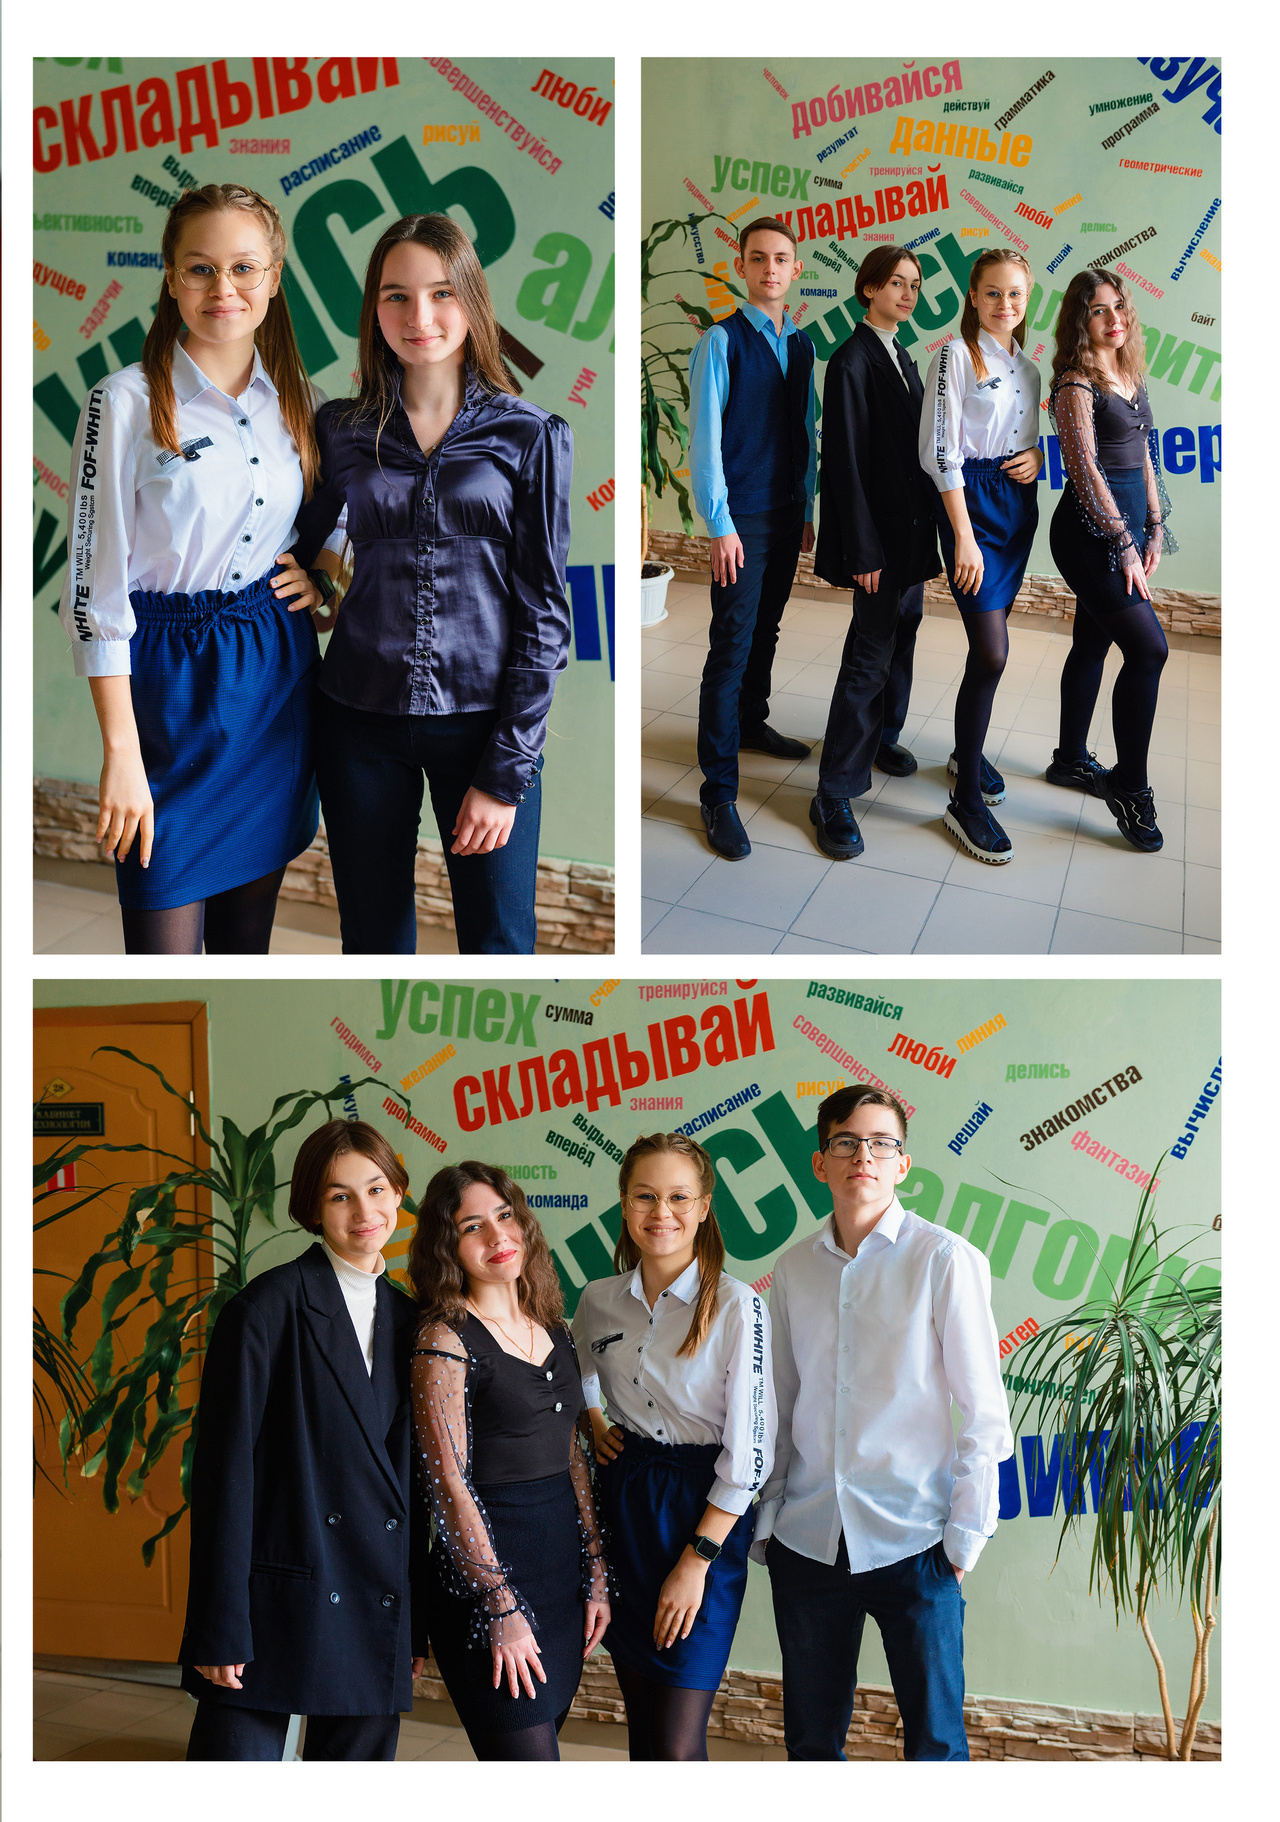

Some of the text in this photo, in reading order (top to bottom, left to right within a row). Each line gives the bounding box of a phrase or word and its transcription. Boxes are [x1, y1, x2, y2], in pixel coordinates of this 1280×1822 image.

[530, 68, 613, 127] люби
[763, 67, 790, 100] человек
[791, 59, 963, 139] добивайся
[994, 70, 1056, 131] грамматика
[943, 99, 990, 113] действуй
[1089, 93, 1153, 116] умножение
[423, 120, 481, 146] рисуй
[889, 116, 1033, 168] данные
[1101, 102, 1160, 150] программа
[229, 137, 291, 154] знания
[280, 123, 382, 195] расписание
[816, 126, 859, 163] результат
[711, 154, 812, 202] успех
[840, 147, 872, 179] счастье
[869, 166, 923, 177] тренируйся
[1119, 157, 1203, 178] геометрические
[682, 177, 715, 213] гордимся
[813, 174, 843, 190] сумма
[968, 168, 1024, 196] развивайся
[776, 162, 950, 243] кладывай
[1014, 202, 1054, 230] люби
[1053, 193, 1083, 217] линия
[959, 187, 1030, 253] совершенствуйся
[960, 224, 990, 239] рисуй
[1080, 221, 1118, 234] делись
[863, 233, 895, 242] знания
[1170, 197, 1222, 282] вычисление
[812, 250, 842, 274] вперёд
[1046, 242, 1074, 275] решай
[800, 287, 838, 298] команда
[1115, 261, 1165, 300] фантазия
[78, 278, 124, 340] задачи
[1190, 311, 1217, 327] байт
[1031, 342, 1046, 363] учи
[568, 367, 598, 409] учи
[76, 545, 84, 568] WILL
[638, 979, 728, 1000] тренируйся
[806, 980, 904, 1021] развивайся
[376, 979, 542, 1048] успех
[545, 1004, 594, 1026] сумма
[330, 1016, 382, 1073] гордимся
[955, 1013, 1008, 1054] линия
[399, 1043, 456, 1092] желание
[452, 979, 776, 1133] складывай
[887, 1032, 957, 1079] люби
[1005, 1062, 1070, 1082] делись
[629, 1095, 683, 1111] знания
[1019, 1065, 1143, 1152] знакомства
[33, 1119, 91, 1129] ЕХНОЛОГИИ
[382, 1097, 448, 1153] программа
[947, 1100, 993, 1156] решай
[545, 1129, 596, 1168] вперёд
[1070, 1128, 1161, 1194] фантазия
[526, 1195, 588, 1211] команда
